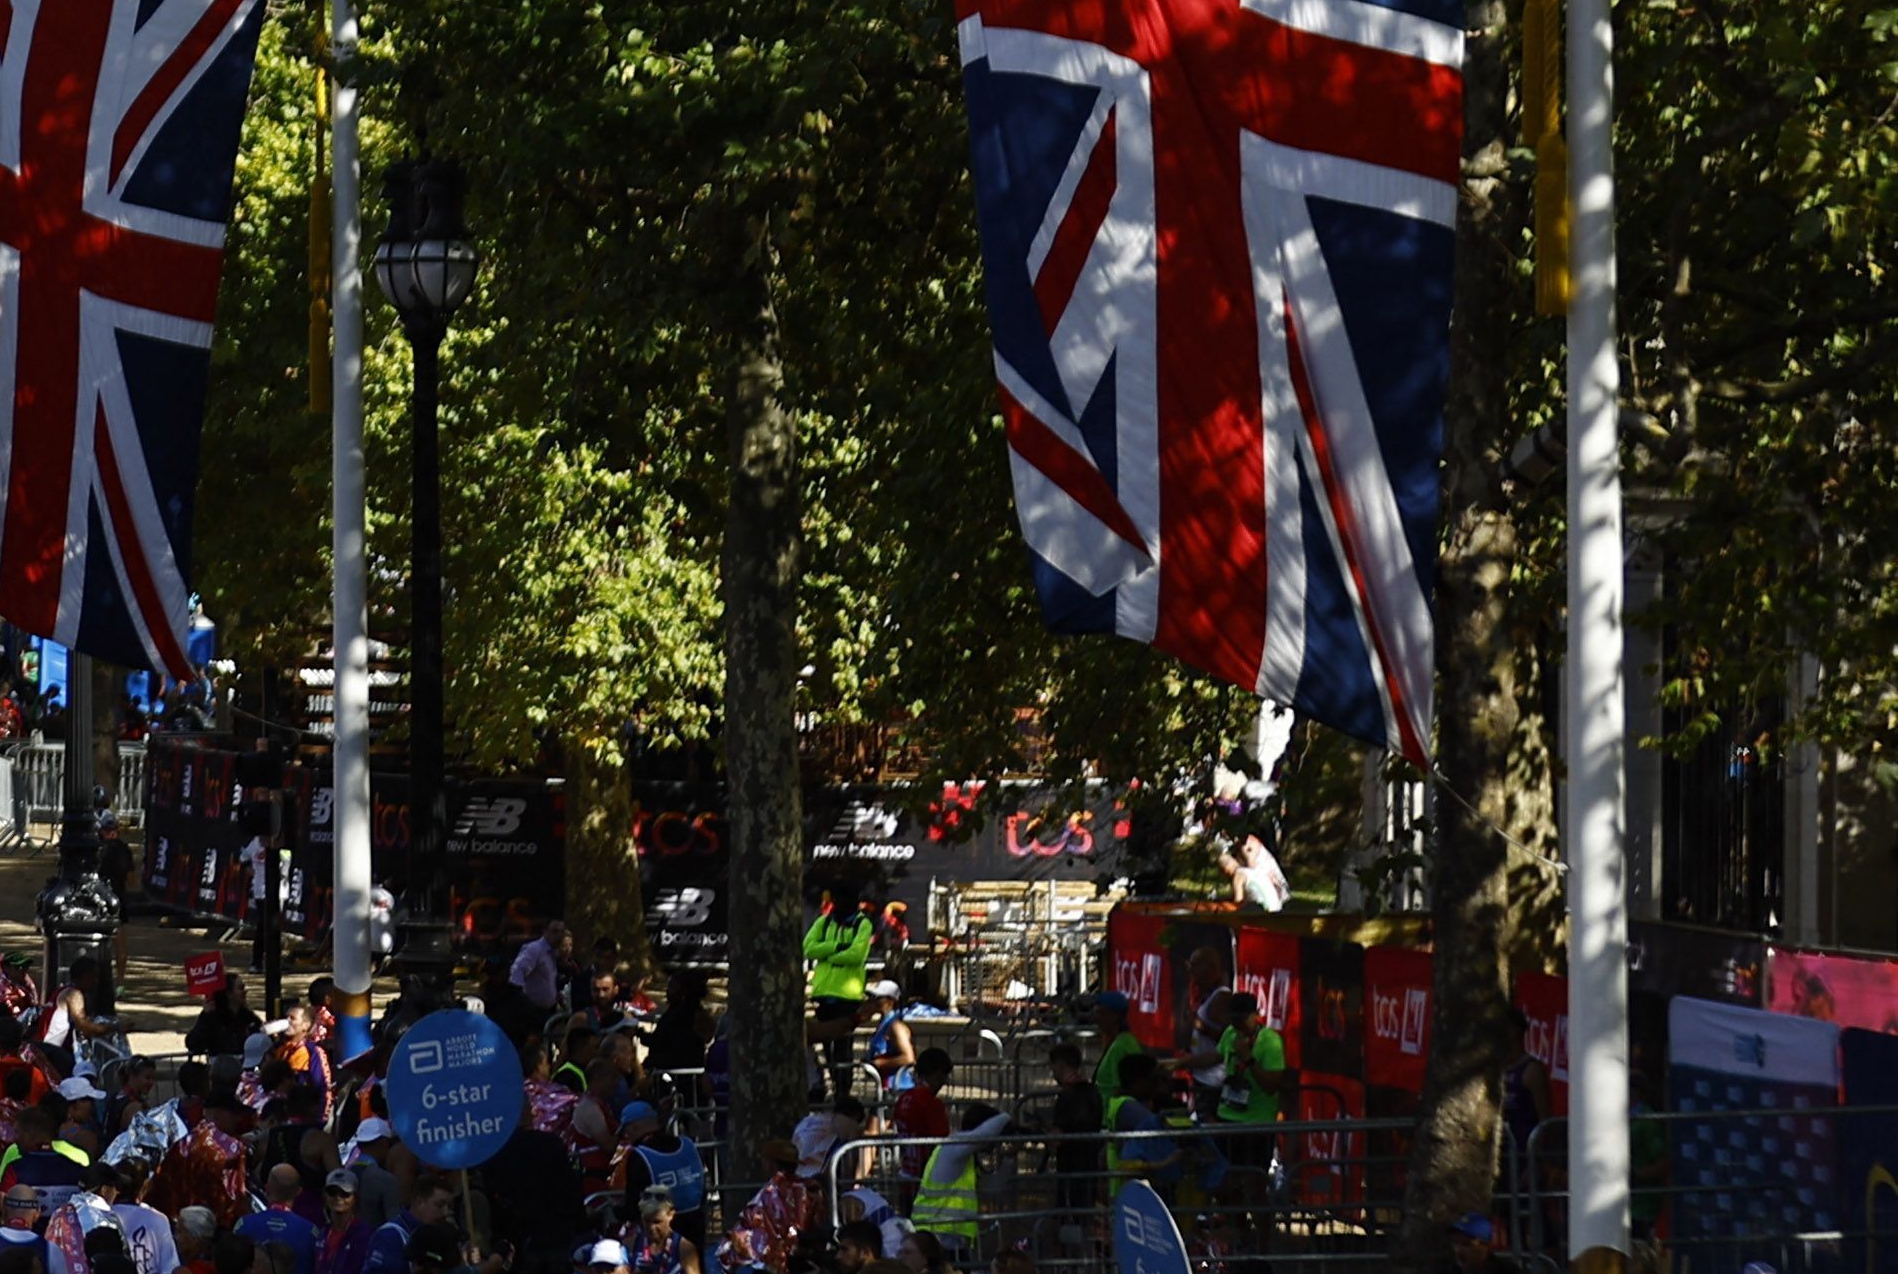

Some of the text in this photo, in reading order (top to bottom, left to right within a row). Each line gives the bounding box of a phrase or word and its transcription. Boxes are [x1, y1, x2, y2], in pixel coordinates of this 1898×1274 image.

[470, 837, 538, 855] balance
[813, 839, 915, 860] new balance
[660, 928, 728, 945] balance
[1115, 947, 1139, 999] tcs
[1372, 984, 1399, 1041] tcs
[446, 1046, 495, 1061] MARATHON
[447, 1058, 484, 1069] MAJORS
[421, 1082, 491, 1110] 6-star
[416, 1111, 504, 1145] finisher
